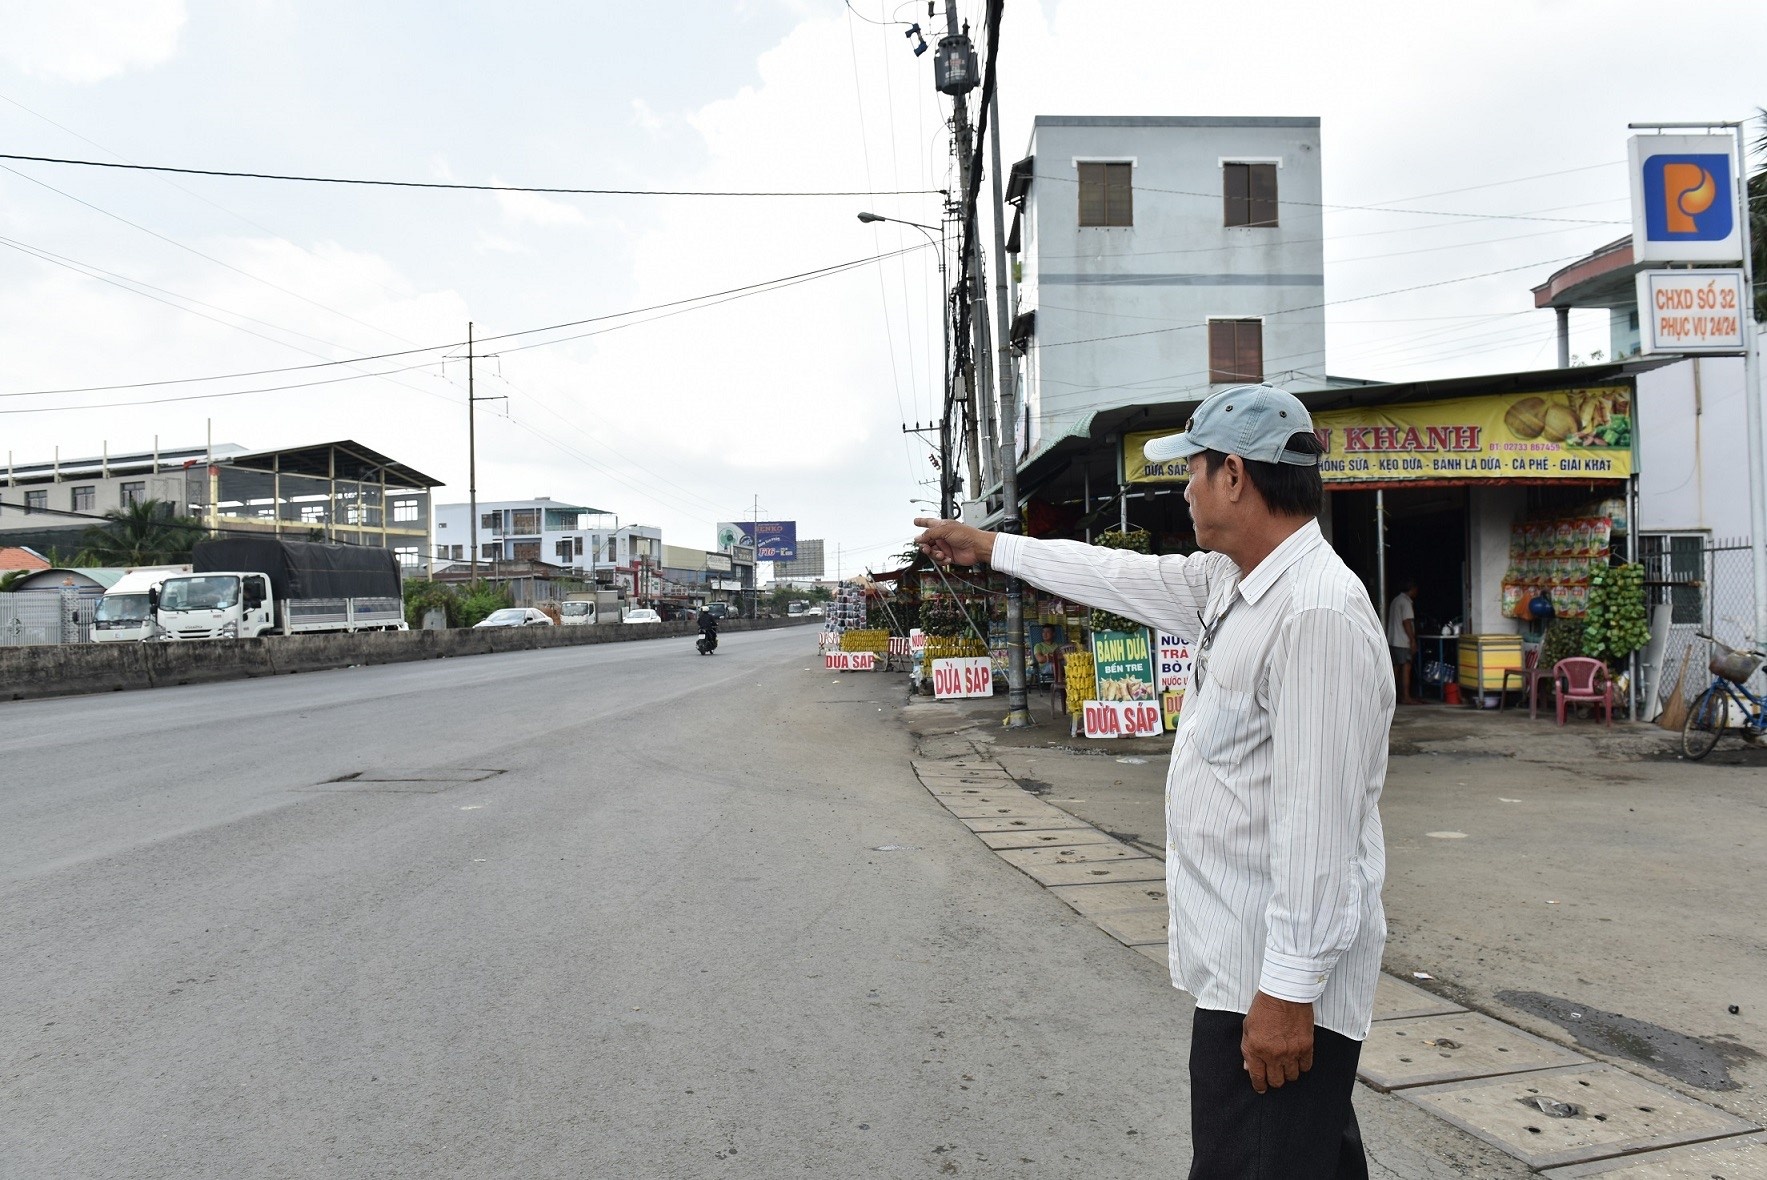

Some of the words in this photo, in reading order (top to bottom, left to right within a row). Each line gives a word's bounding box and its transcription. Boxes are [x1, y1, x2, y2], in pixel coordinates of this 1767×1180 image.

[1656, 288, 1693, 310] CHXD
[1697, 279, 1717, 310] SỐ
[1720, 288, 1736, 310] 32
[1661, 316, 1690, 341] PHỤC
[1692, 316, 1708, 341] VỤ
[1343, 426, 1481, 453] KHANH
[1504, 442, 1528, 451] 02733
[1379, 459, 1399, 474] KẸO
[1433, 457, 1462, 471] BÁNH
[1585, 456, 1612, 471] KHÁT
[1097, 634, 1126, 663] BÁNH
[1126, 633, 1148, 660] DỪA
[1161, 647, 1189, 659] TRÀ
[935, 662, 962, 695] DỪA
[966, 660, 990, 694] SÁP
[1105, 662, 1124, 674] BẾN
[1126, 663, 1144, 673] TRE
[1162, 660, 1182, 673] BÒ
[1085, 702, 1122, 735] DỪA
[1124, 702, 1159, 734] SÁP
